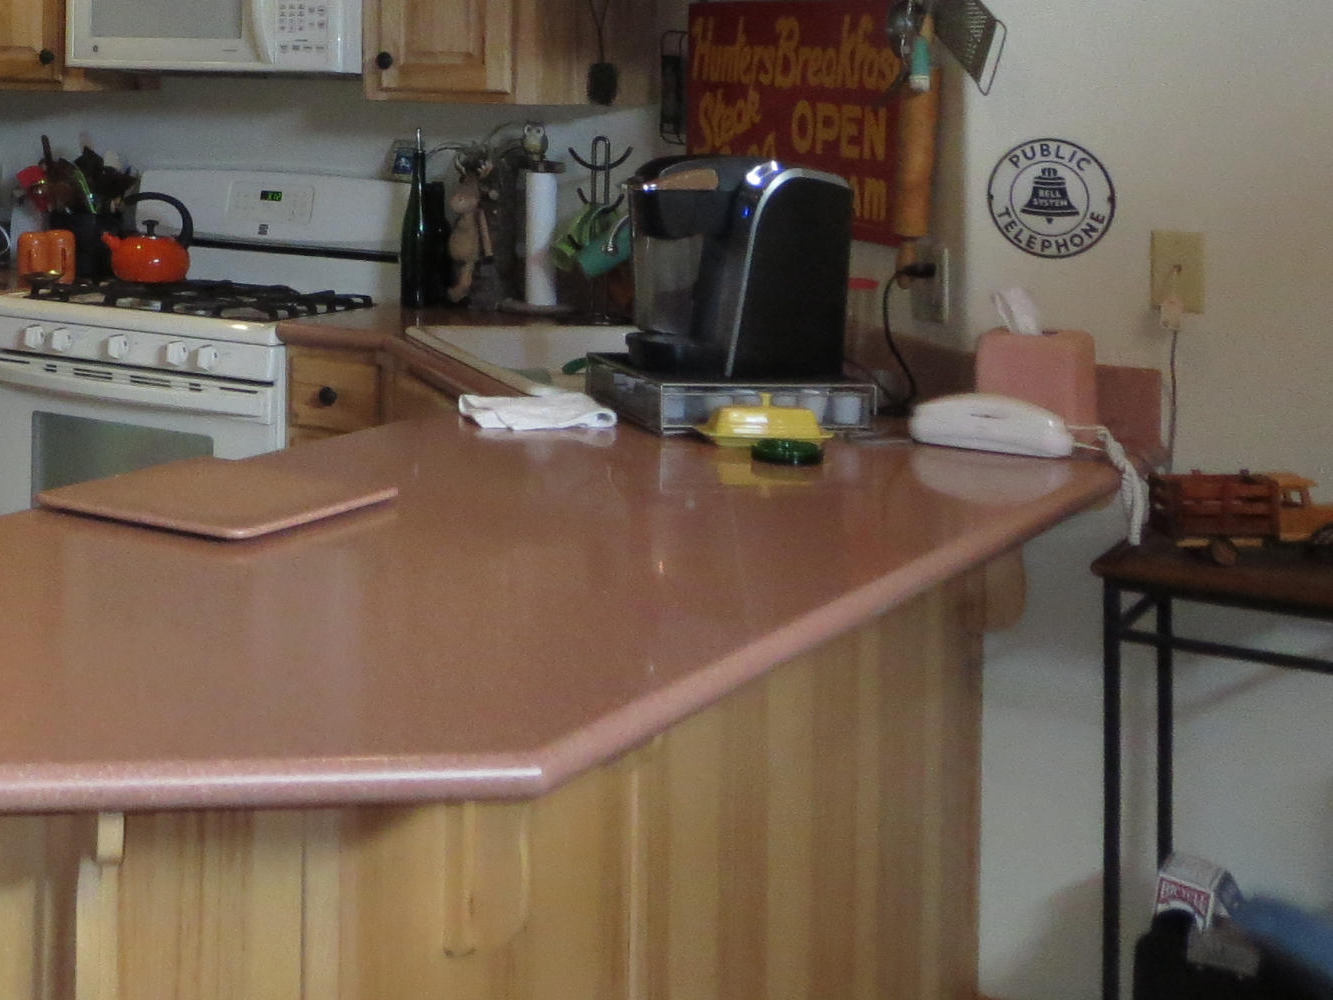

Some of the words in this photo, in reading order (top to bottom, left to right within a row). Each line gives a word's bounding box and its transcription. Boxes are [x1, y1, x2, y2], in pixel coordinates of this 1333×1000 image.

[774, 14, 901, 92] Breakfas
[791, 100, 886, 160] OPEN
[1008, 143, 1092, 171] PUBLIC
[1038, 189, 1062, 198] BELL
[998, 206, 1106, 254] TELEPHONE
